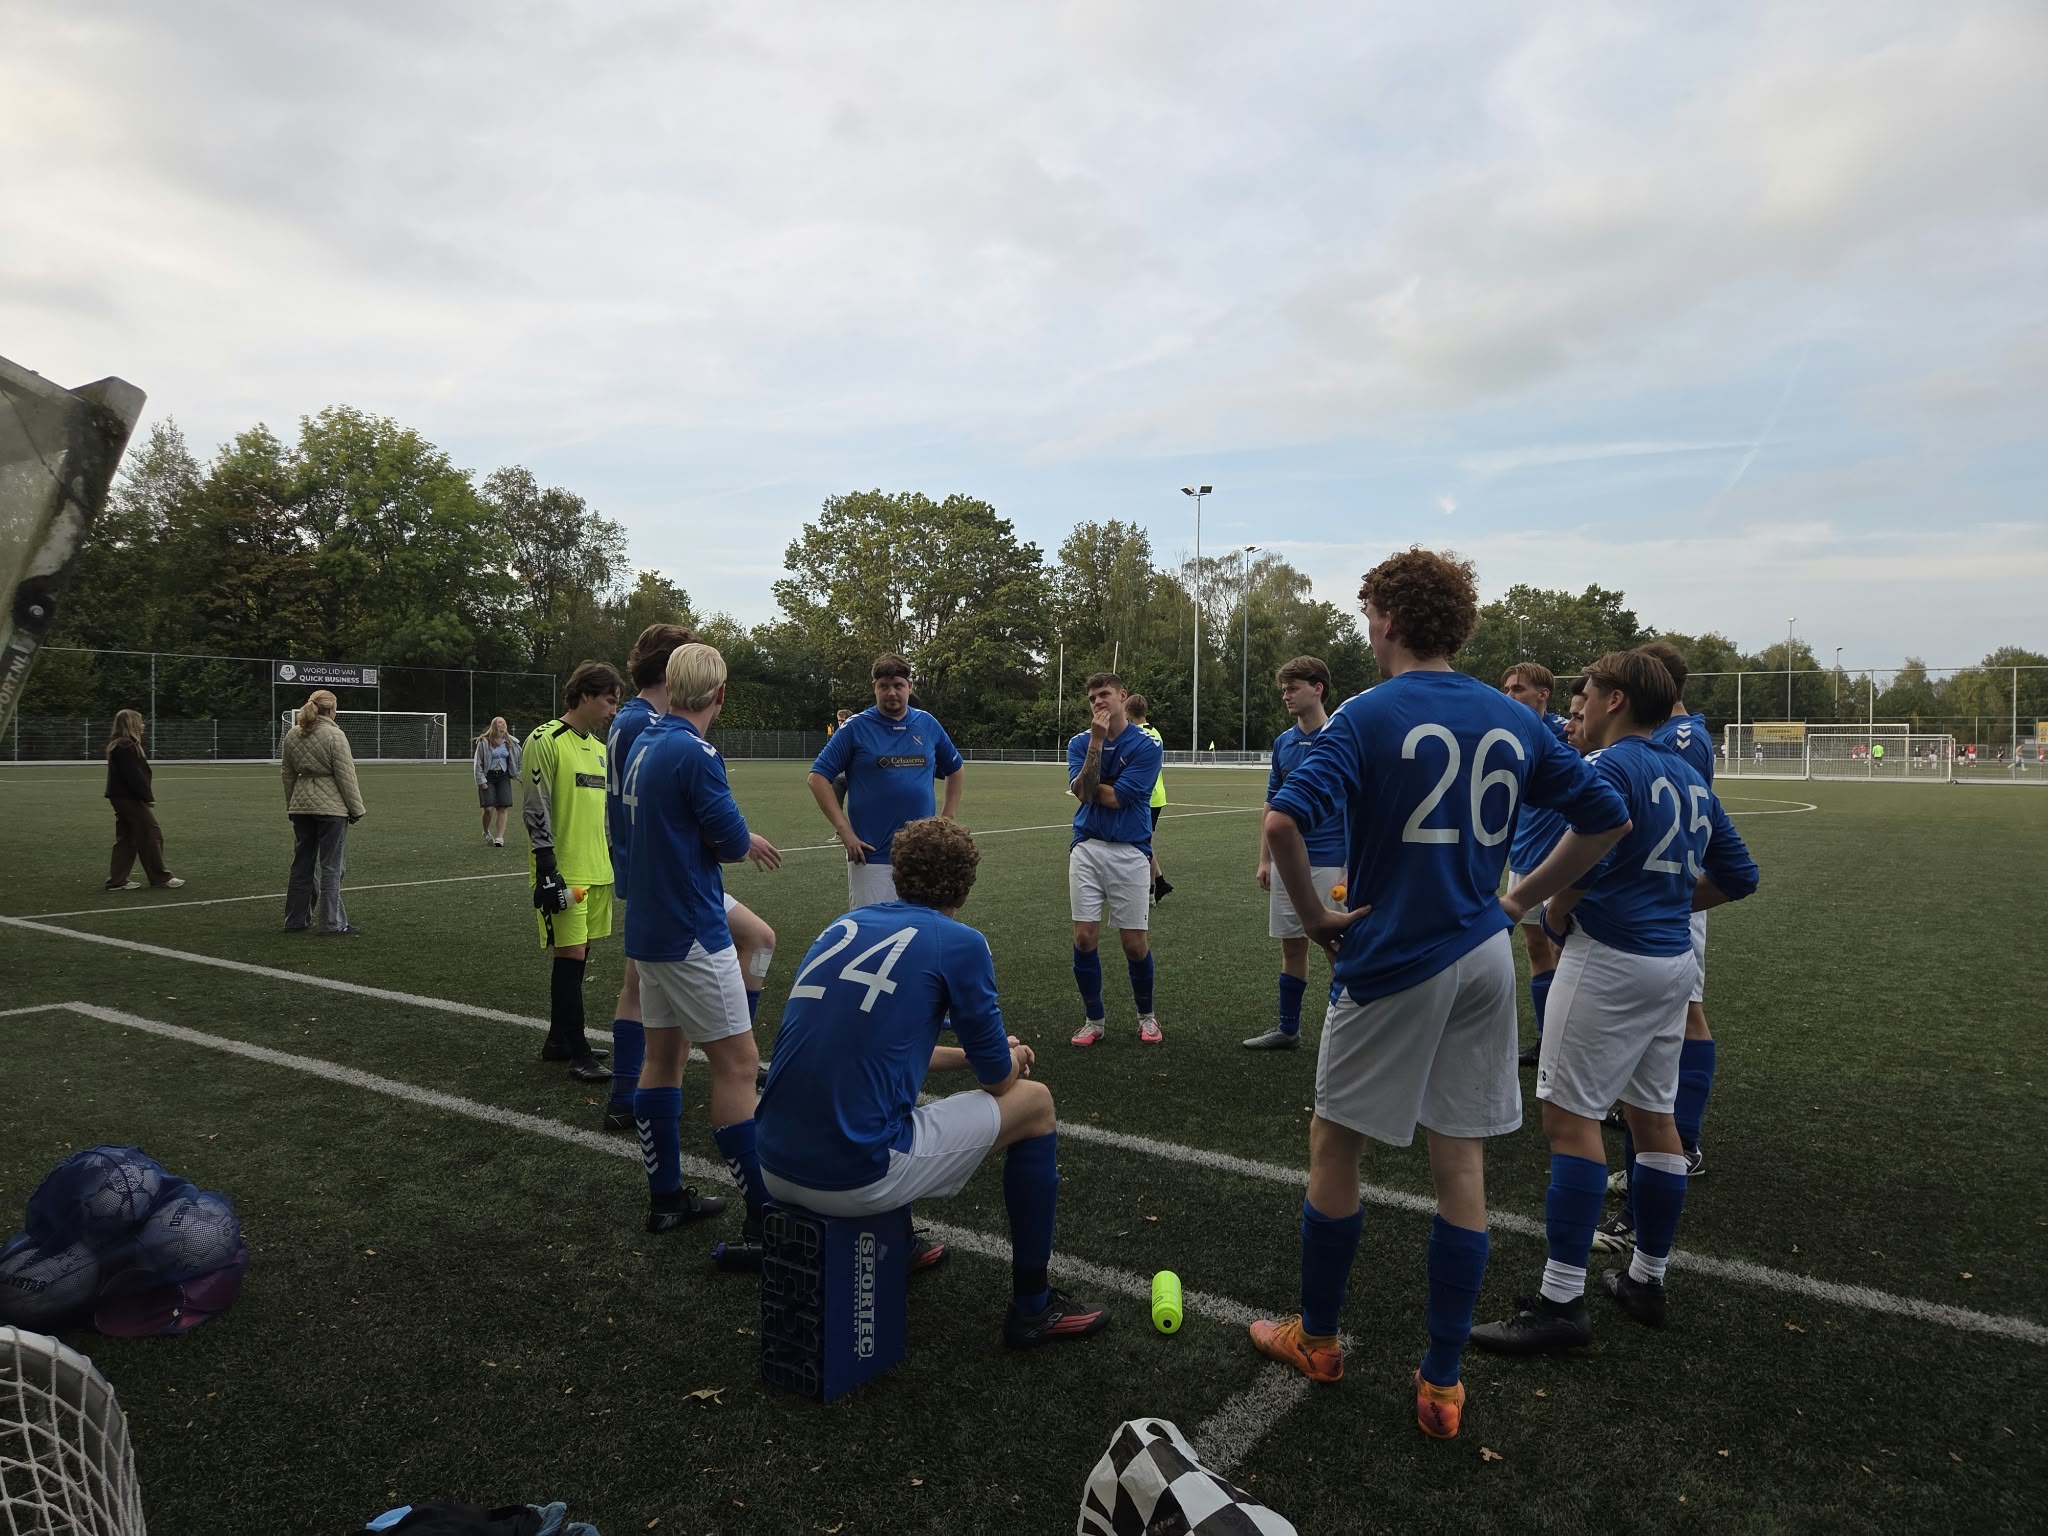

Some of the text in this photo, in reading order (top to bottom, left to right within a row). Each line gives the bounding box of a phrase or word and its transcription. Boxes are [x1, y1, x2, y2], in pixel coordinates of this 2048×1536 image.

[324, 676, 360, 684] BUSINESS
[1401, 723, 1525, 847] 26
[1642, 776, 1713, 880] 25
[788, 918, 919, 1013] 24
[859, 1239, 875, 1353] SPORTEC
